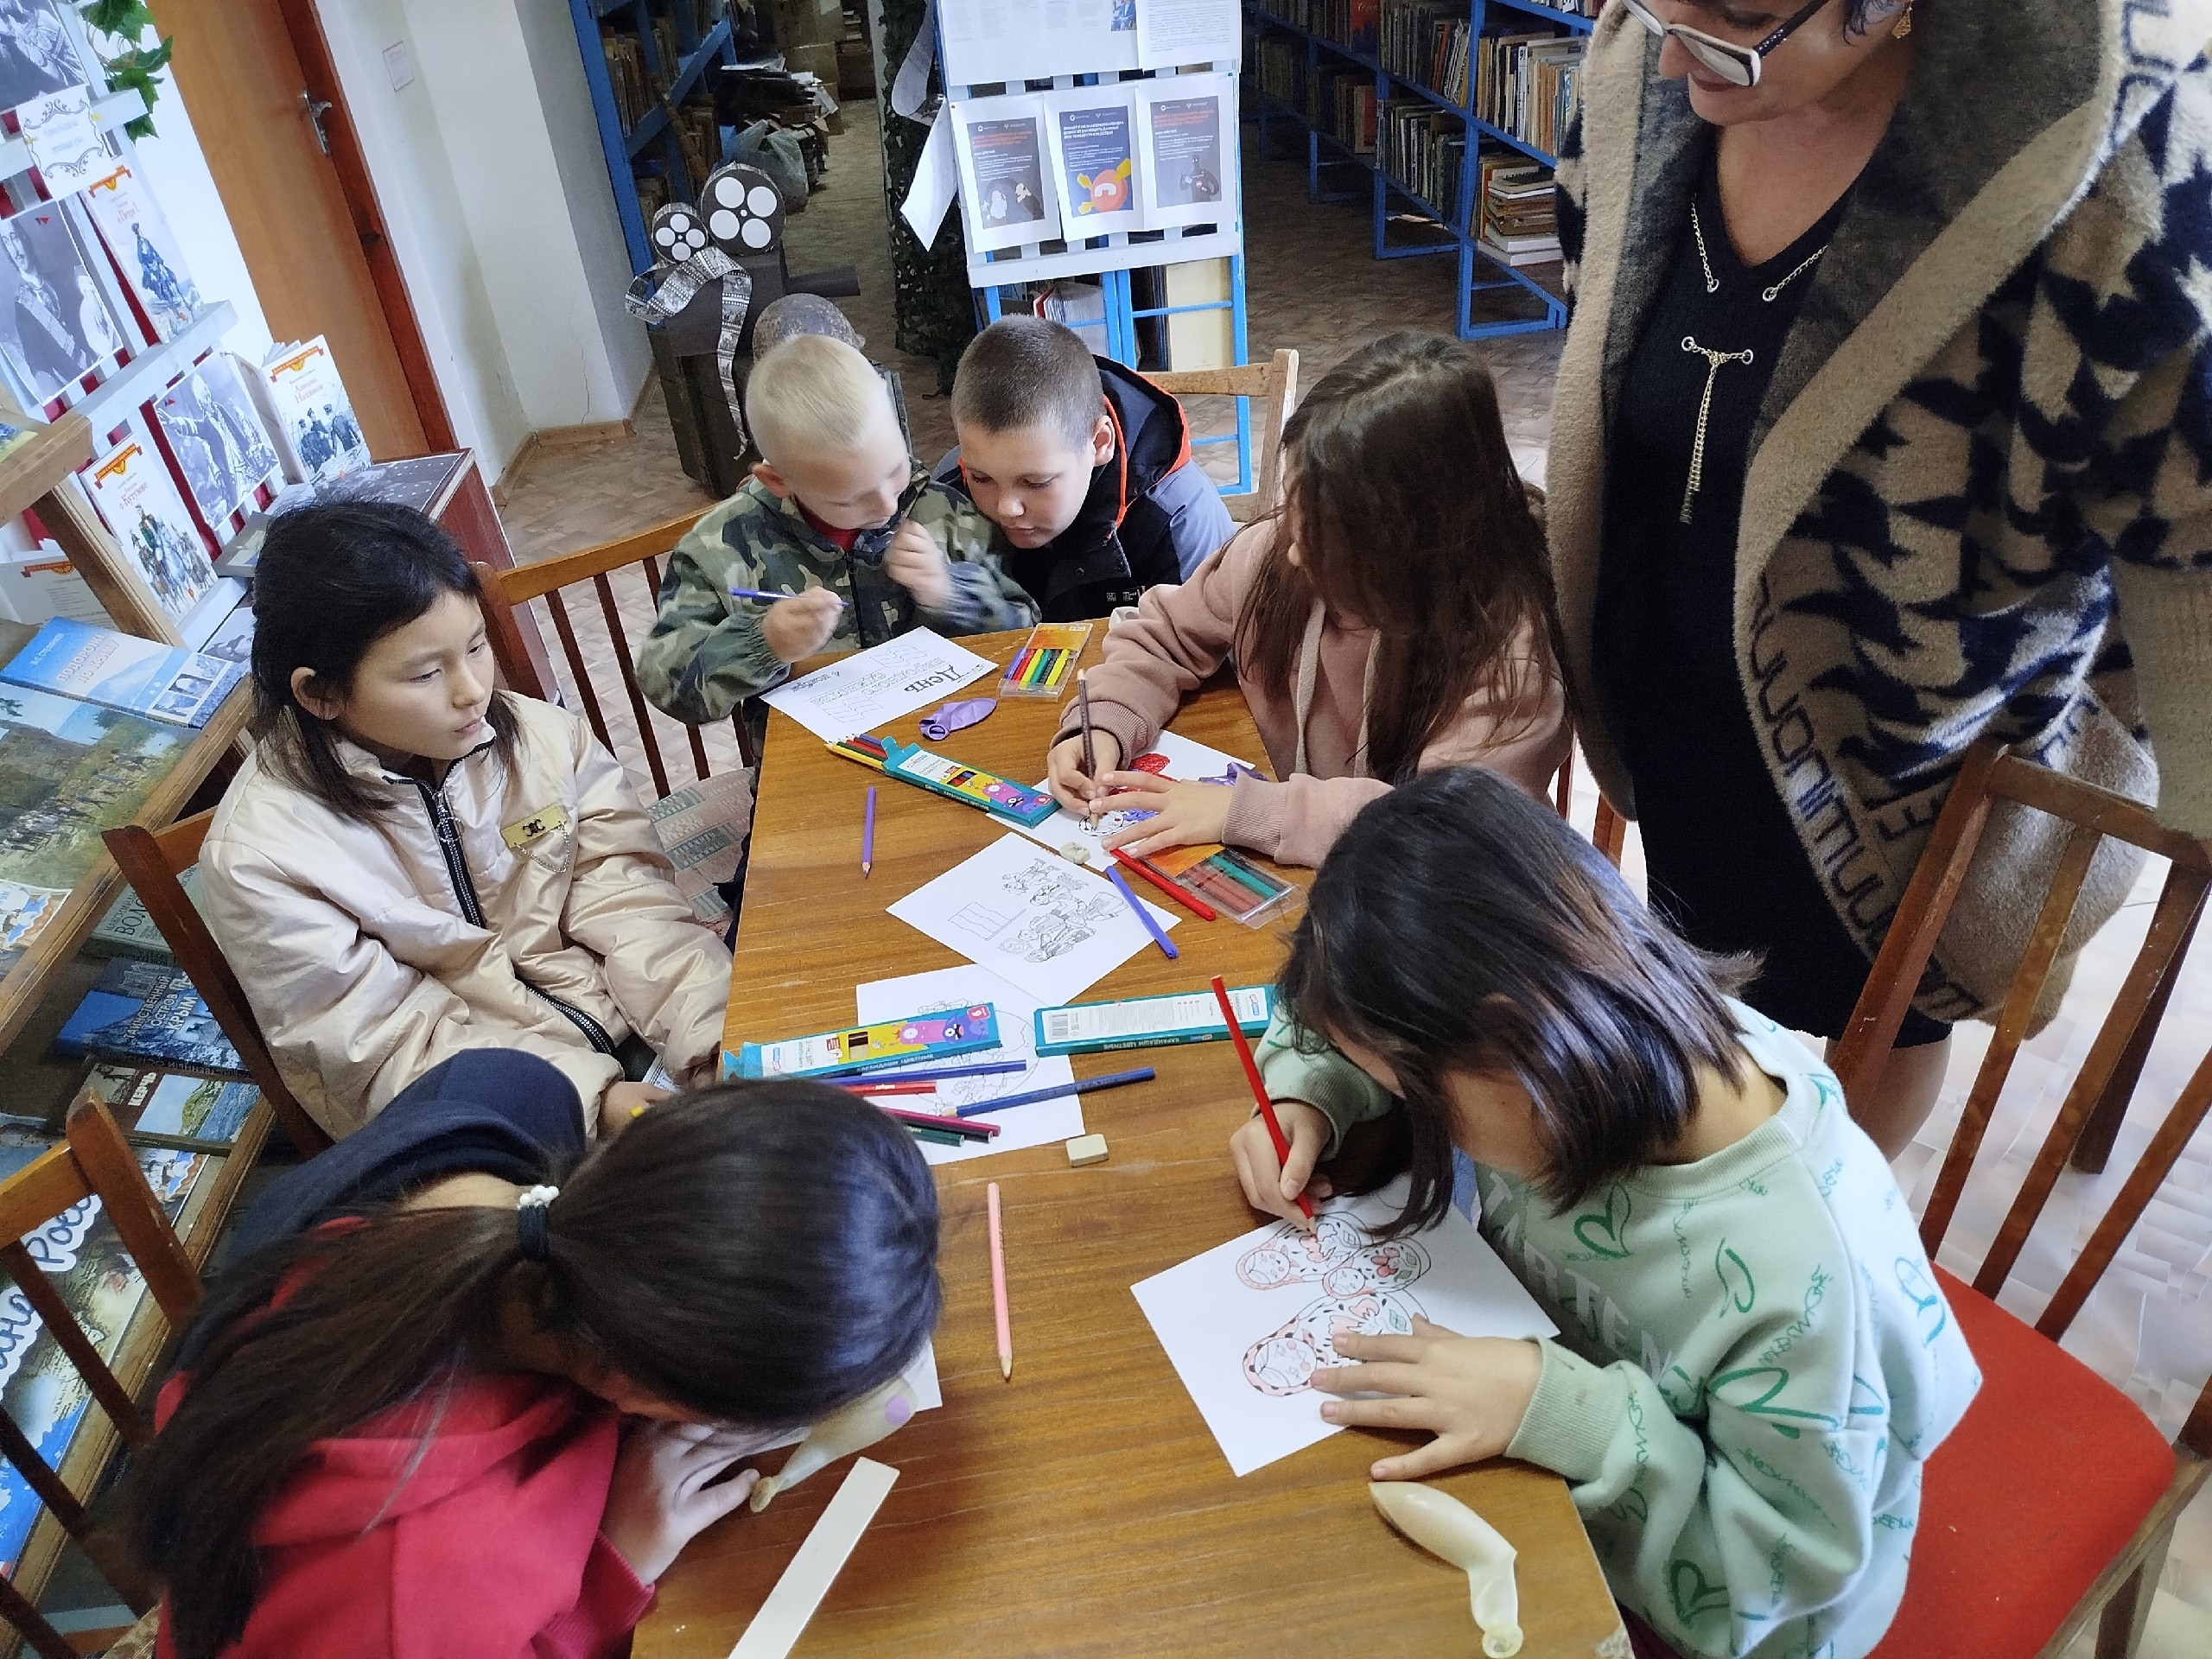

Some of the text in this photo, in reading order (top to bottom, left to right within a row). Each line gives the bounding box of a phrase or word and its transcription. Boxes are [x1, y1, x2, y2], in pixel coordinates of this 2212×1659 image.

[295, 385, 324, 404] Нахимов
[121, 482, 149, 506] Кутузове
[810, 671, 887, 706] единства
[861, 657, 945, 696] народного
[904, 664, 963, 694] День
[124, 975, 172, 1039] ТАИНСТВЕННЫЙ
[149, 993, 179, 1027] ОСТРОВ
[165, 995, 200, 1031] КРЫМ
[804, 1039, 814, 1067] ЦВЕТНЫЕ
[1137, 1037, 1179, 1047] КАРАНДАШИ
[128, 1071, 157, 1107] КЕРЧЬ
